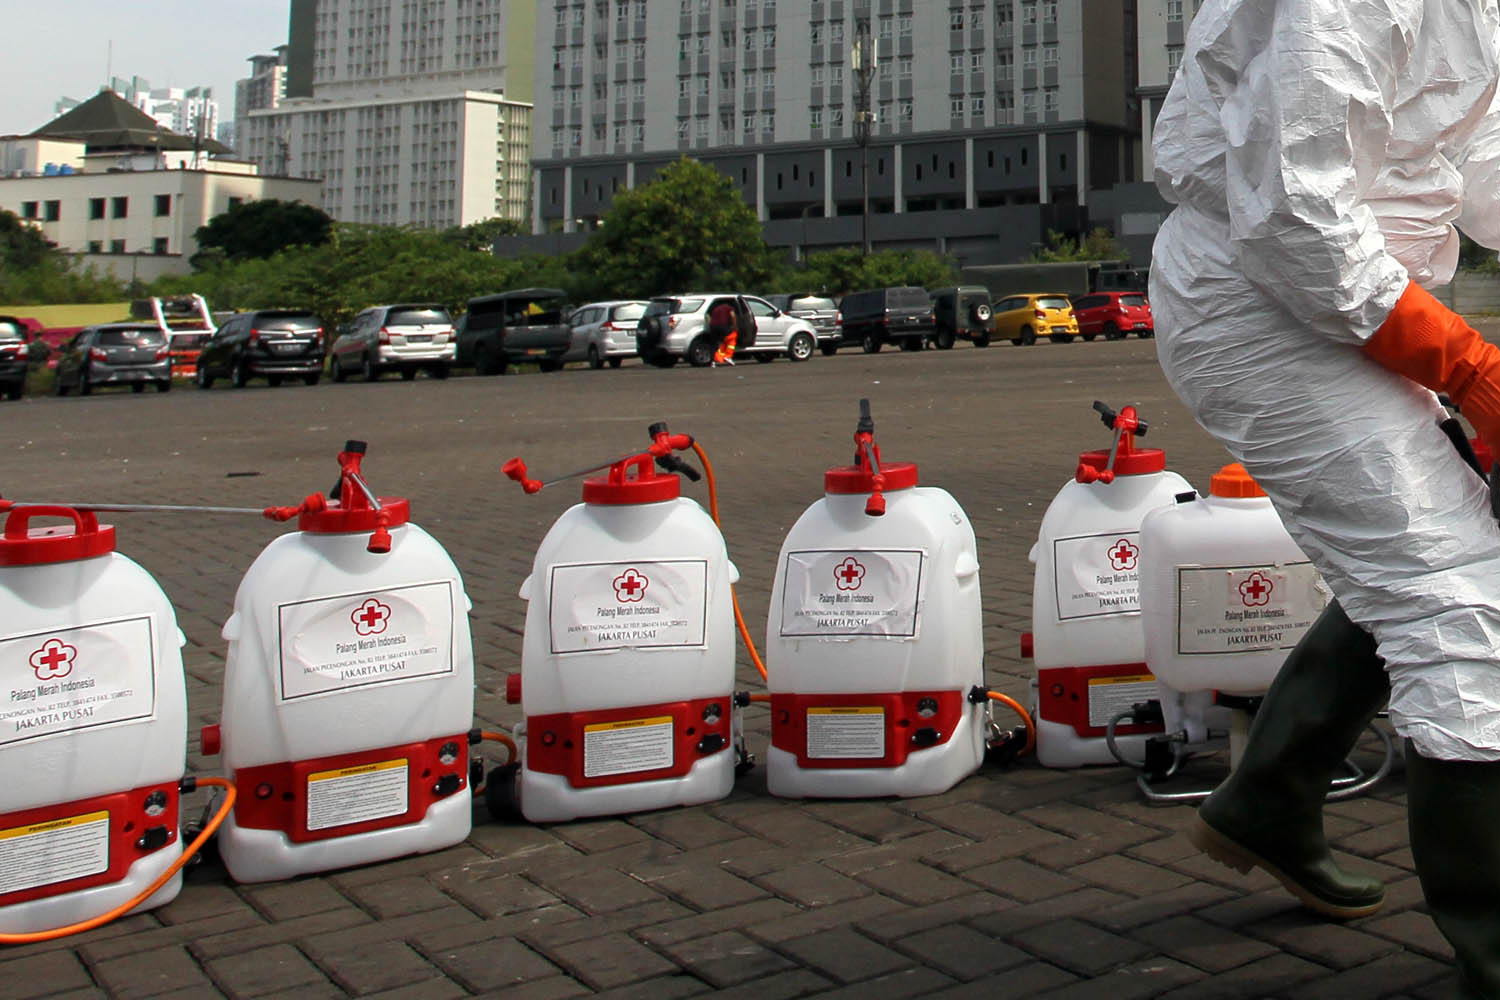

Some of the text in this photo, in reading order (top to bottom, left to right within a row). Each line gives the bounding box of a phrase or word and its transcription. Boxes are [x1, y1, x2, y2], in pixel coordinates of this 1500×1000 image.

[1096, 575, 1112, 585] Palang
[819, 593, 874, 605] Palang Merah Indonesia
[1099, 597, 1128, 608] JAKARTA
[597, 606, 660, 618] Palang Merah Indonesia
[1225, 608, 1285, 622] Palang Merah Indonesia
[817, 619, 868, 628] JAKARTA PUSAT
[598, 630, 656, 642] JAKARTA PUSAT
[1227, 633, 1282, 646] JAKARTA PUSAT
[336, 634, 406, 654] Palang Merah Indonesia
[340, 660, 406, 680] JAKARTA PUSAT
[11, 677, 95, 701] Palang Merah Indonesia
[0, 709, 35, 720] CENONGAN
[16, 706, 94, 732] JAKARTA PUSAT
